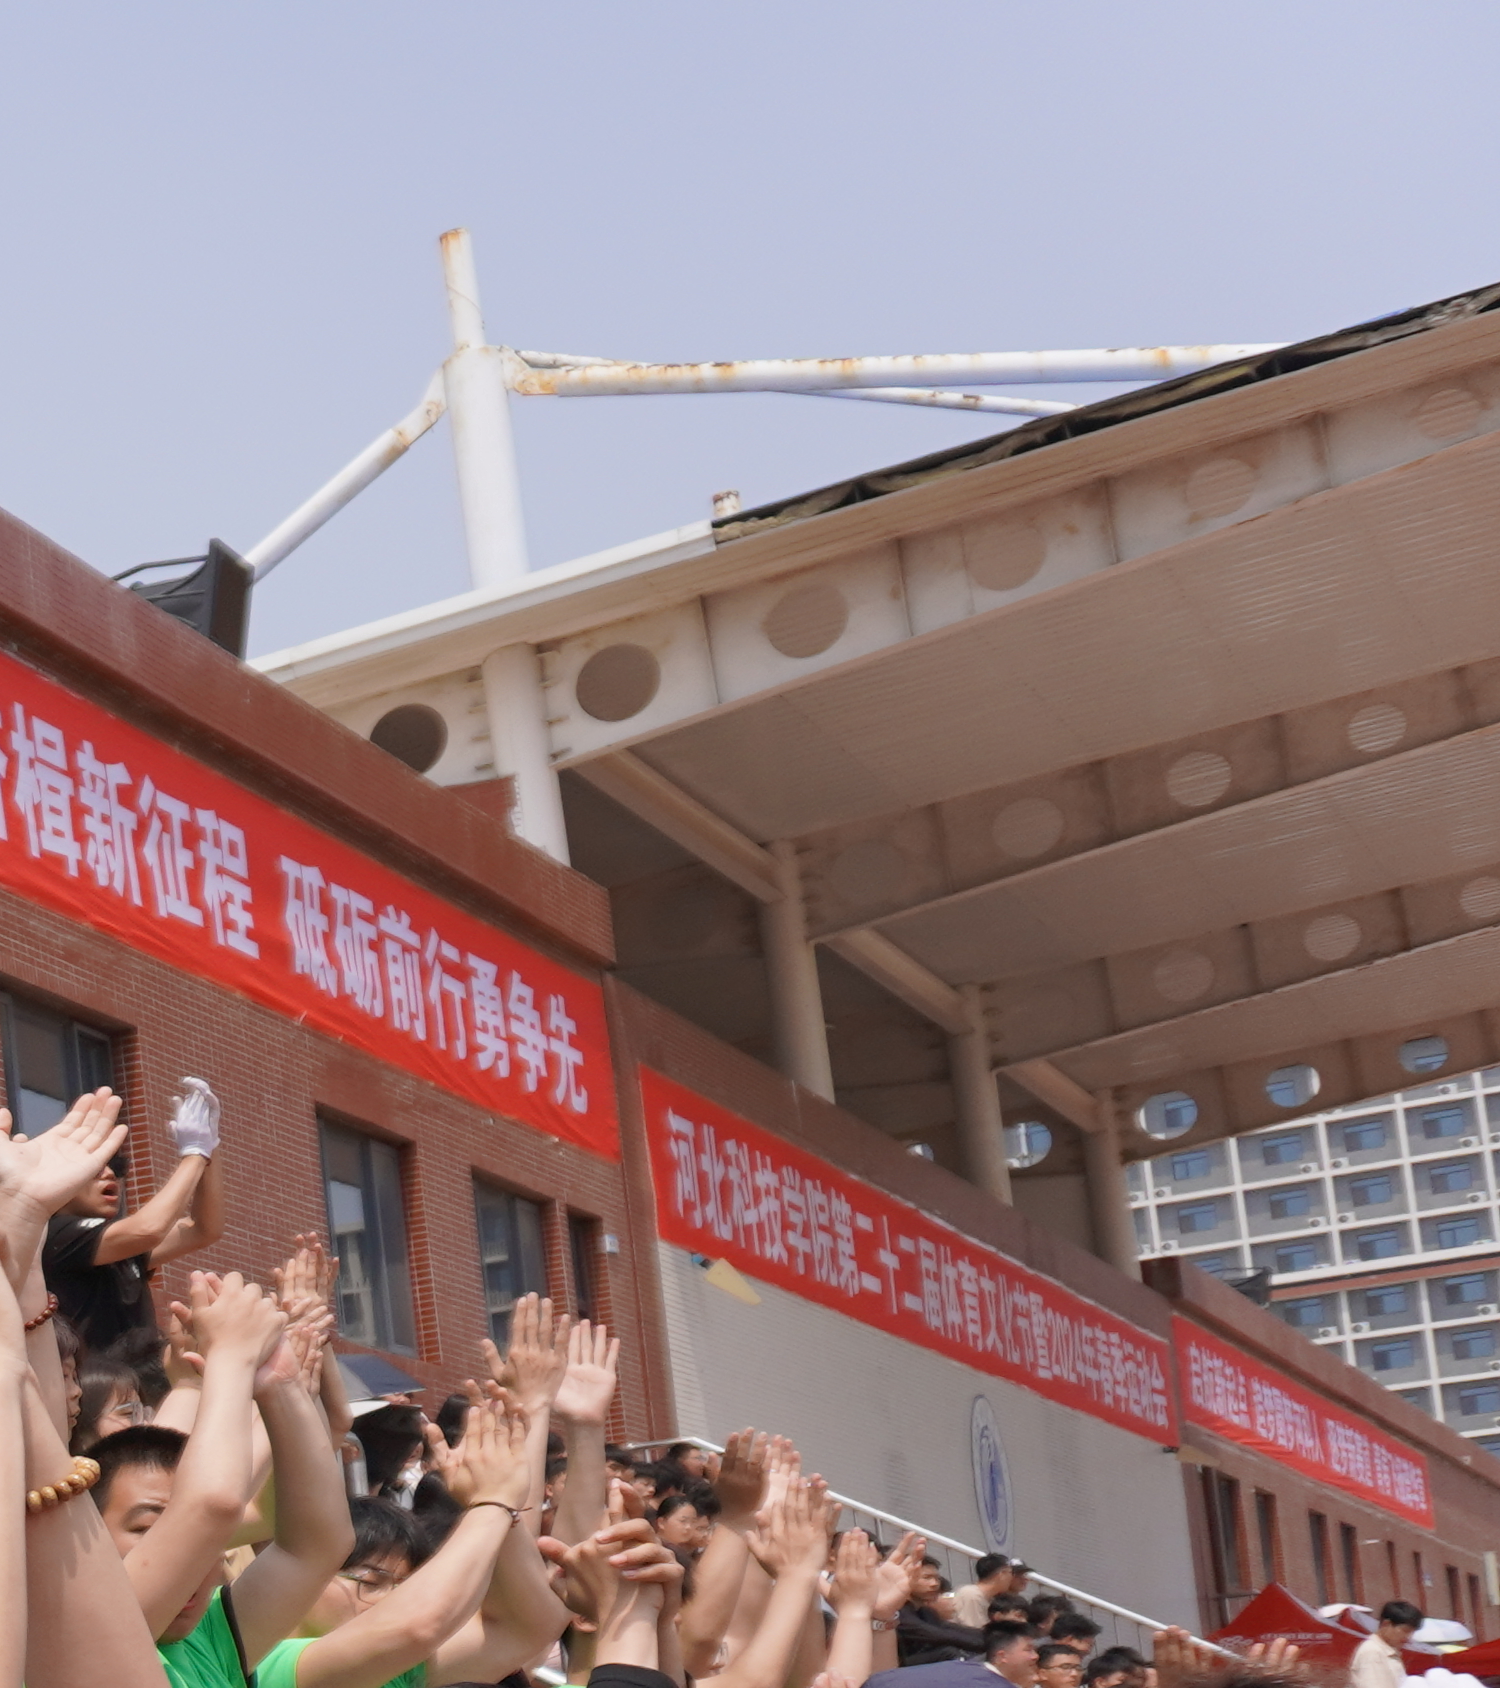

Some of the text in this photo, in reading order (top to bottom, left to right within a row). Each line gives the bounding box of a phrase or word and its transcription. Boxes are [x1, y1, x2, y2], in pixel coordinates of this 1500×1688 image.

[278, 853, 590, 1117] 砥砺前行勇争先
[668, 1107, 1169, 1429] 河北科技学院第二十二届体育文化节暨2024年春季运动会
